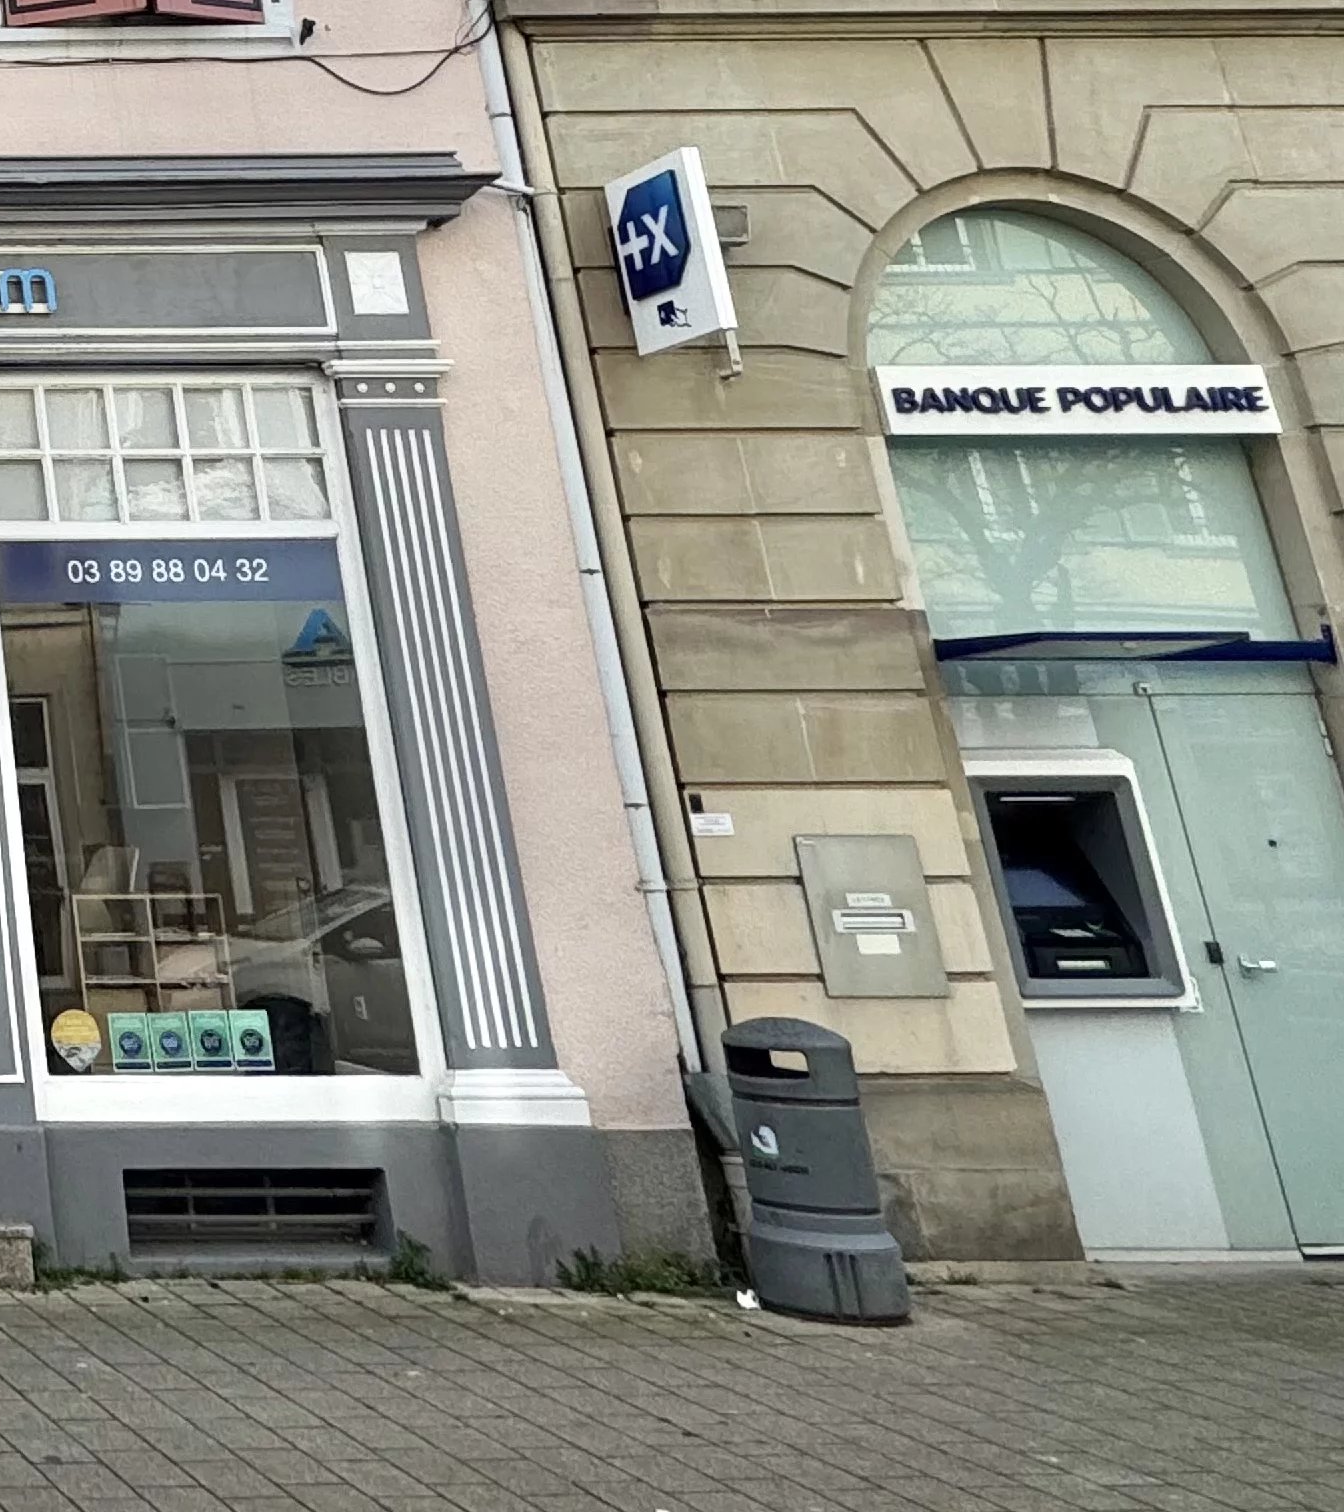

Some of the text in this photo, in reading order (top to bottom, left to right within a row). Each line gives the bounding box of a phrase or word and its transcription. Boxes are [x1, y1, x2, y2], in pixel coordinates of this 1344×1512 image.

[891, 386, 1269, 413] BANQUE POPULAIRE
[67, 558, 270, 583] 03 89 88 04 32
